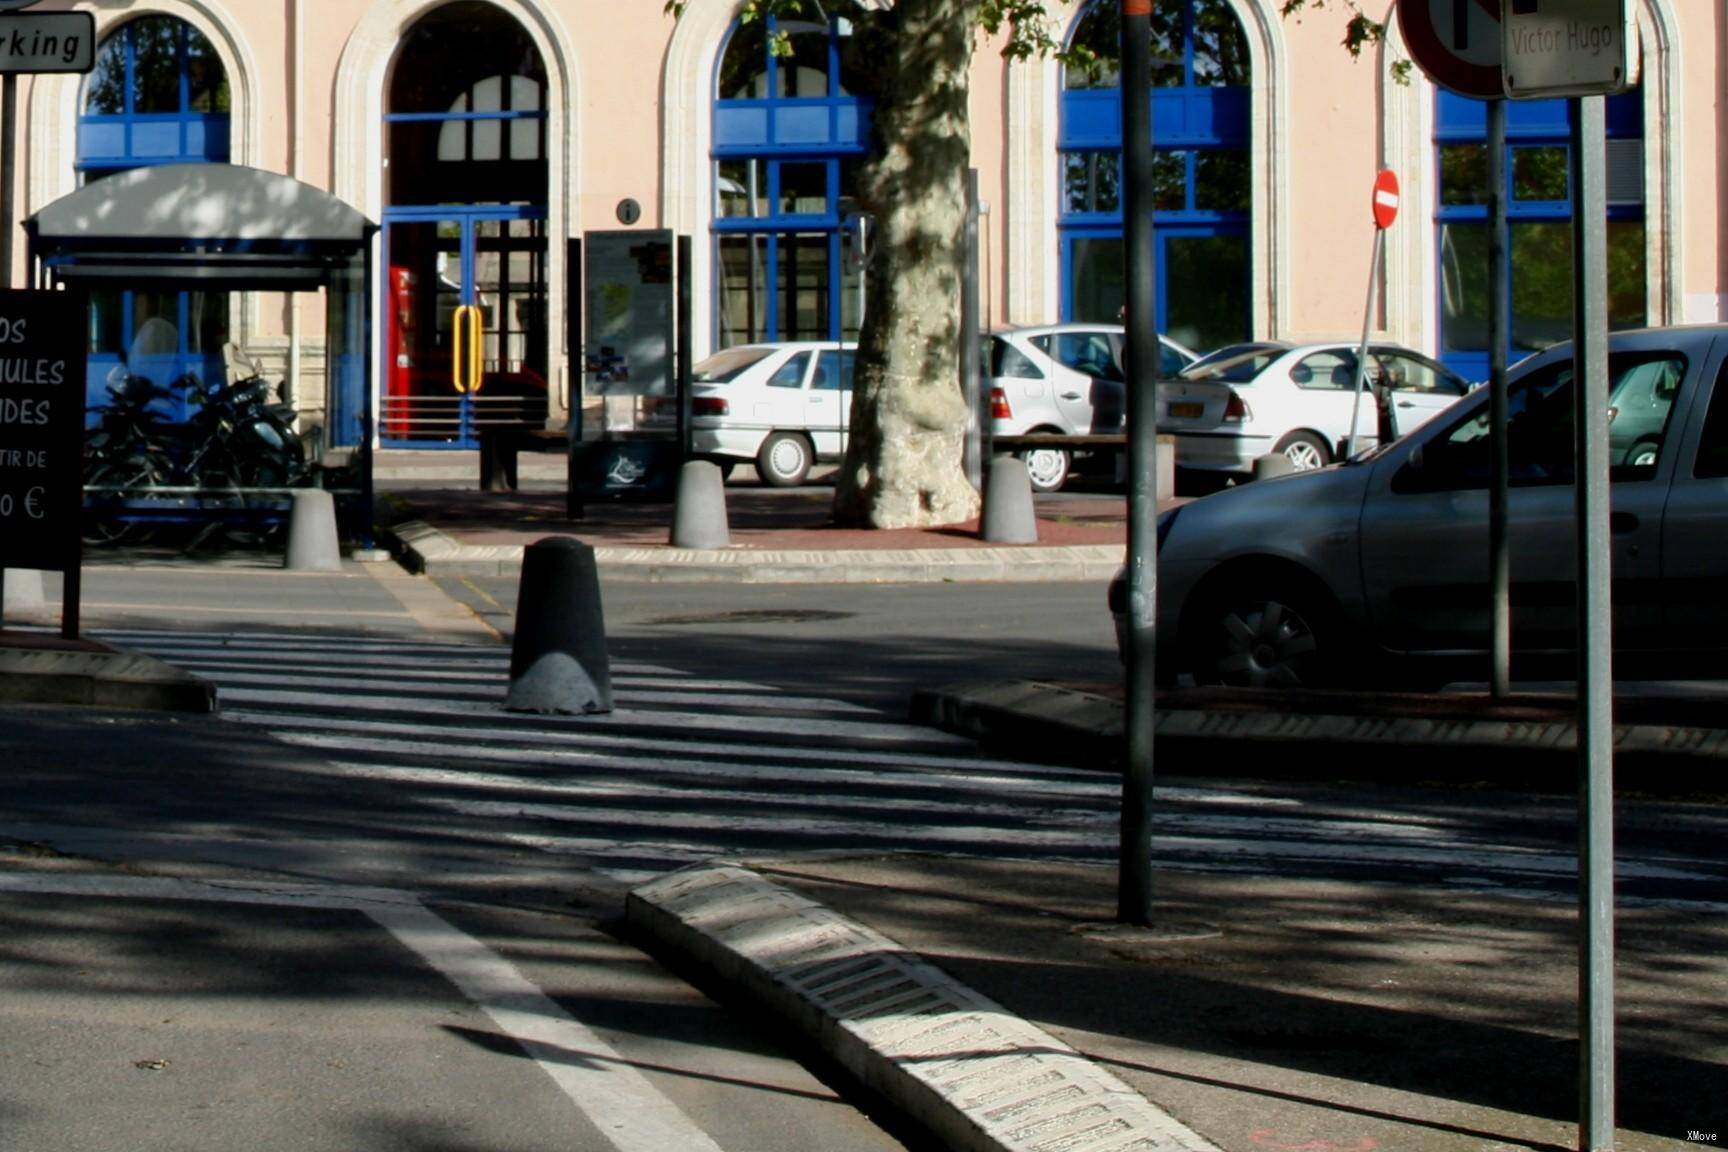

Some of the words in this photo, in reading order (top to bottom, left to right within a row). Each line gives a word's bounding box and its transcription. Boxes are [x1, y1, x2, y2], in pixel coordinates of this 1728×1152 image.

[1512, 25, 1561, 56] Victor
[1567, 20, 1613, 56] Hugo
[27, 450, 47, 468] DE
[24, 486, 45, 519] €
